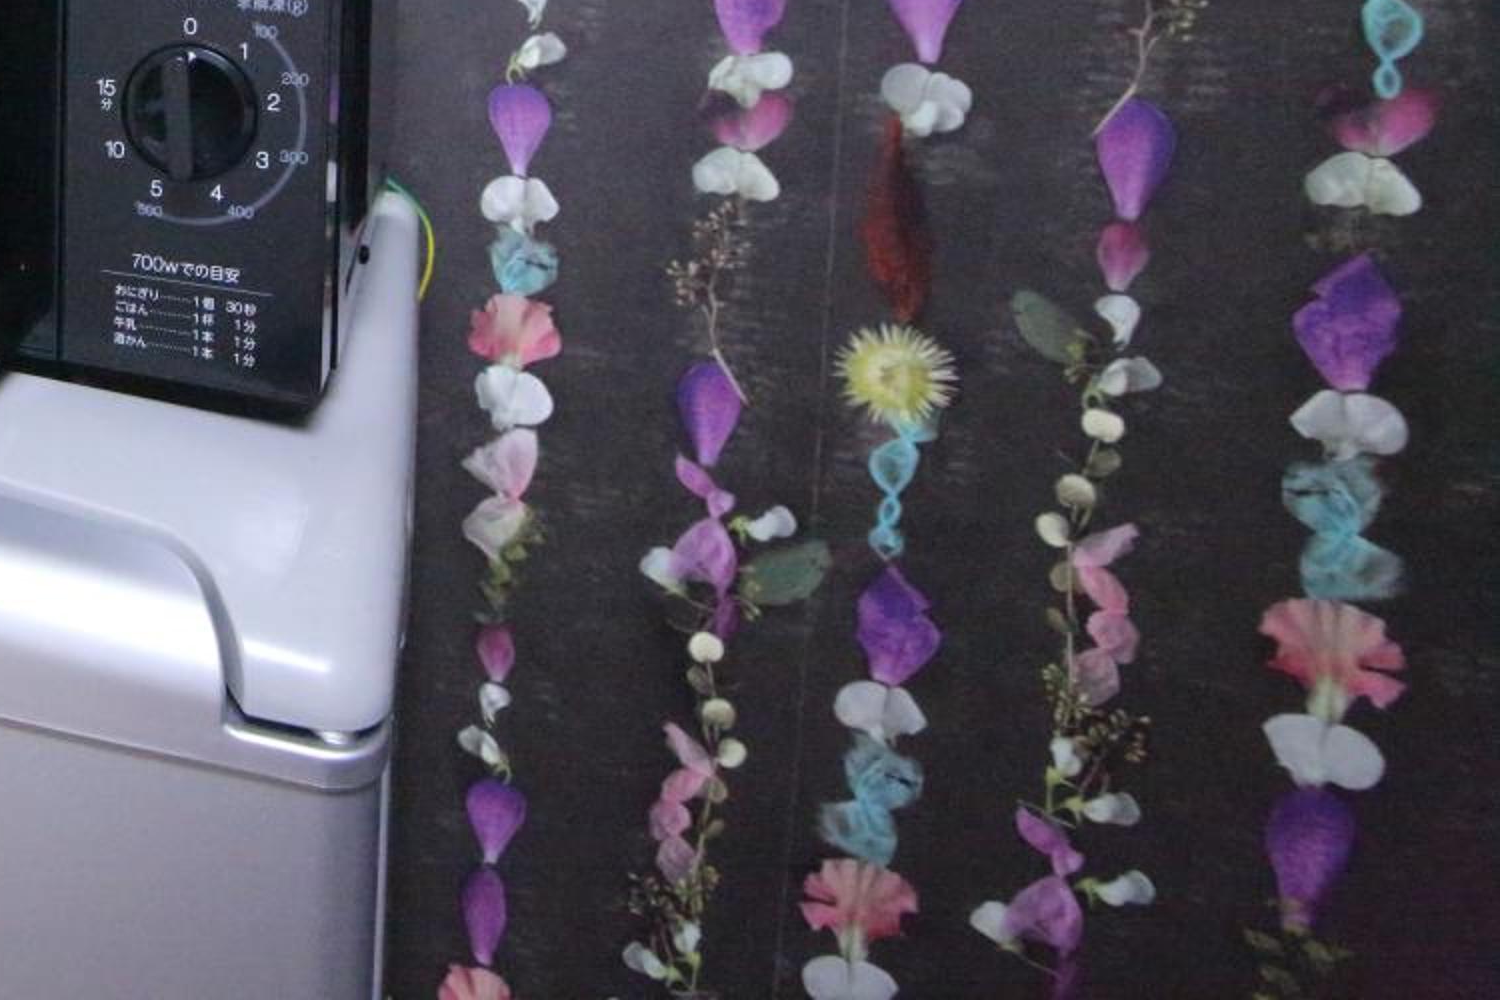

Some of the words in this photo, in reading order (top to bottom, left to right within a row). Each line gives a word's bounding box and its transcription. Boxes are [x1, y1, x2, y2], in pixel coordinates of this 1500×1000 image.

[183, 18, 197, 35] 0
[239, 42, 248, 60] 1
[97, 79, 116, 97] 15
[101, 98, 112, 111] 分
[267, 93, 281, 112] 2
[104, 141, 125, 159] 10
[256, 151, 269, 168] 3
[150, 179, 163, 197] 5
[210, 184, 224, 200] 4
[115, 284, 159, 301] おにぎり
